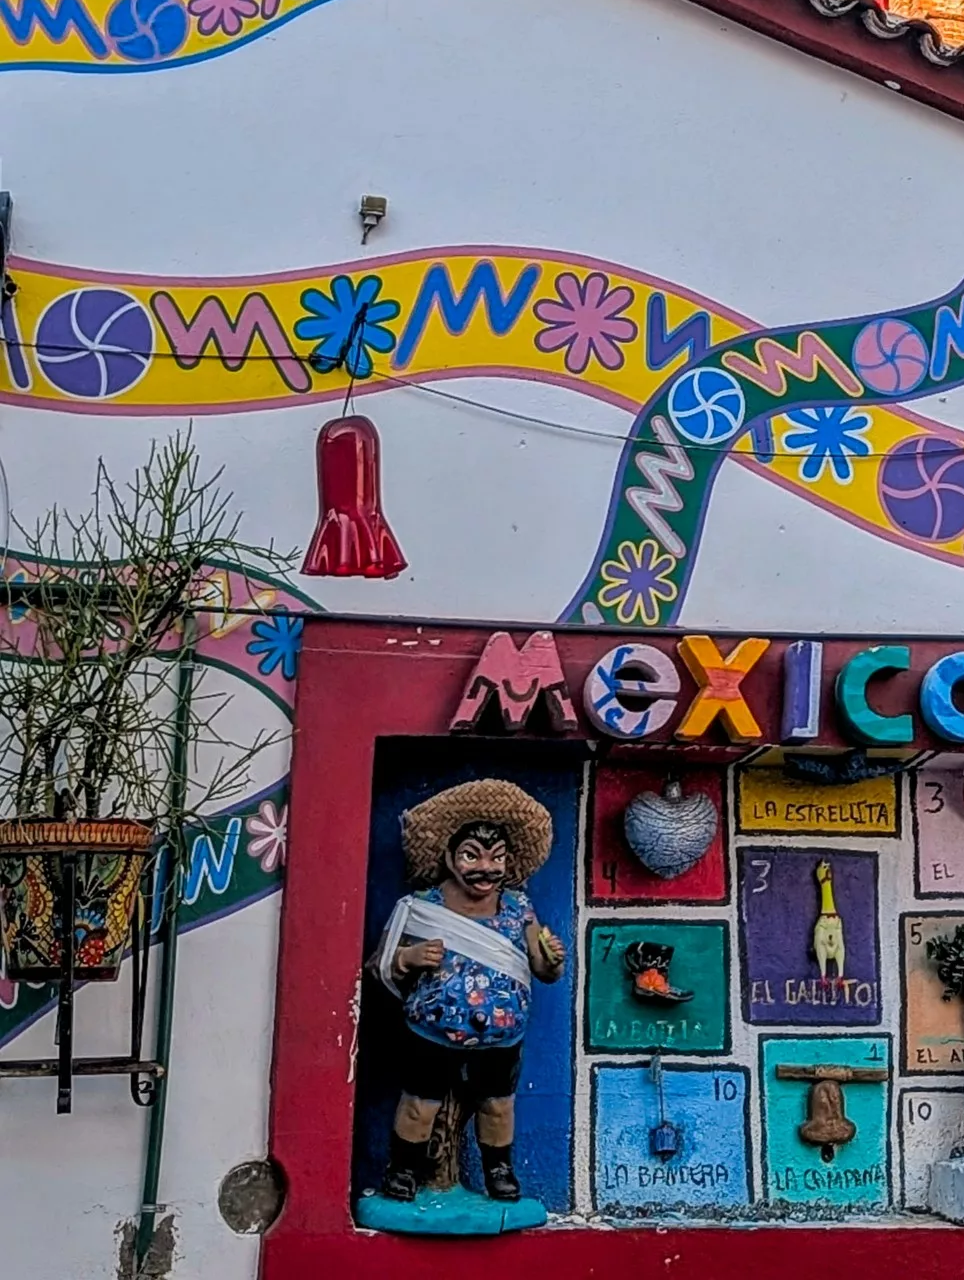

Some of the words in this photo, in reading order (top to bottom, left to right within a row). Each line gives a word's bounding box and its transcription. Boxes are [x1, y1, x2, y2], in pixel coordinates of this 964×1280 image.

[924, 782, 944, 813] 3
[754, 800, 777, 819] LA
[601, 862, 617, 892] 4
[751, 860, 771, 893] 3
[933, 863, 953, 880] EL
[910, 923, 922, 945] 5
[599, 933, 616, 961] 7
[864, 1044, 883, 1061] 1
[917, 1049, 938, 1063] EL
[714, 1078, 737, 1101] 10
[908, 1099, 932, 1125] 10
[604, 1165, 629, 1189] LA
